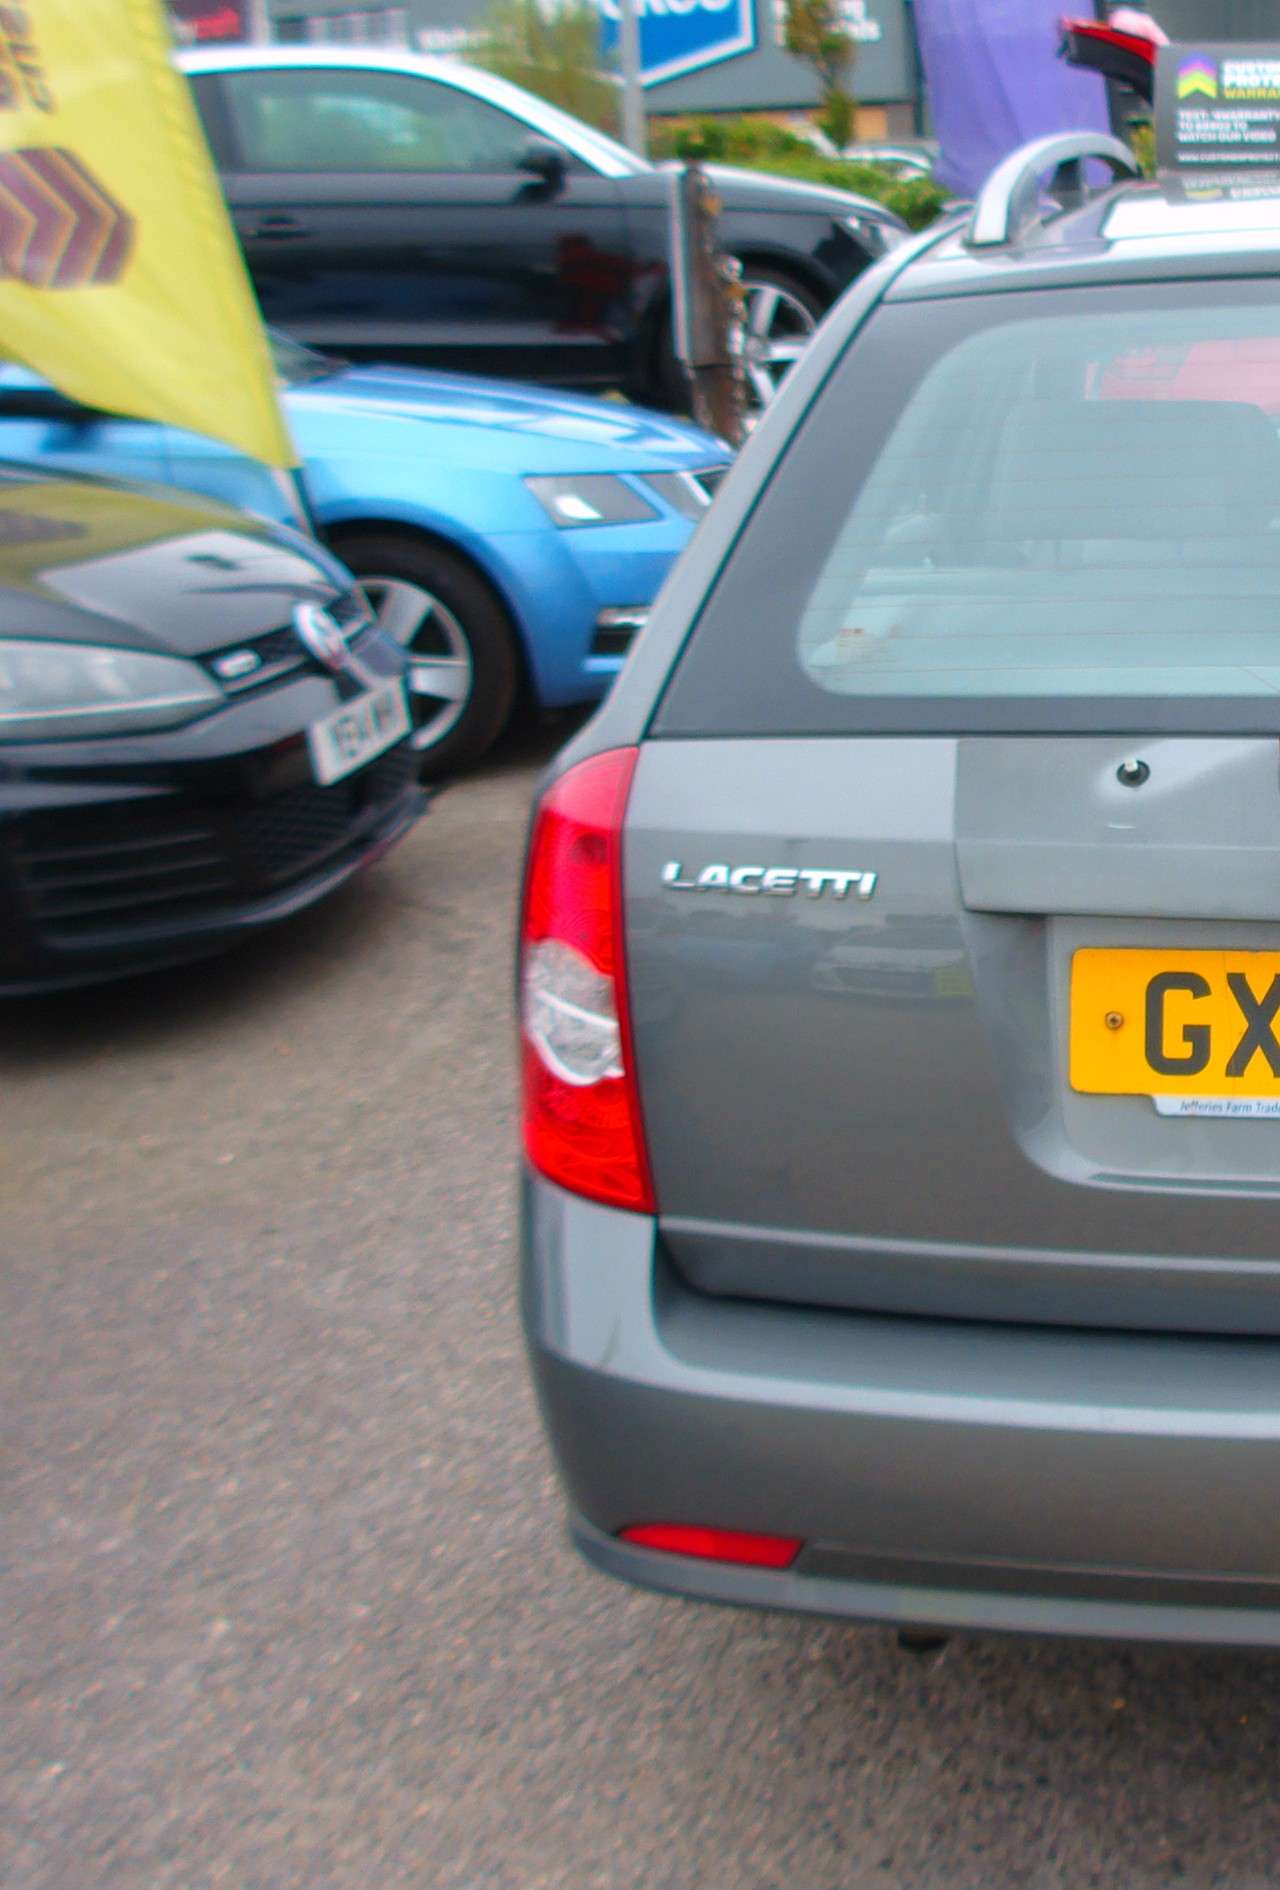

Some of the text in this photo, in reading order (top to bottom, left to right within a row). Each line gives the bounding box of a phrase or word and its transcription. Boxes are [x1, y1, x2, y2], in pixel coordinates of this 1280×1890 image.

[661, 860, 878, 900] LACETTI
[1180, 1100, 1223, 1112] Jefferies
[1226, 1102, 1252, 1112] Farm
